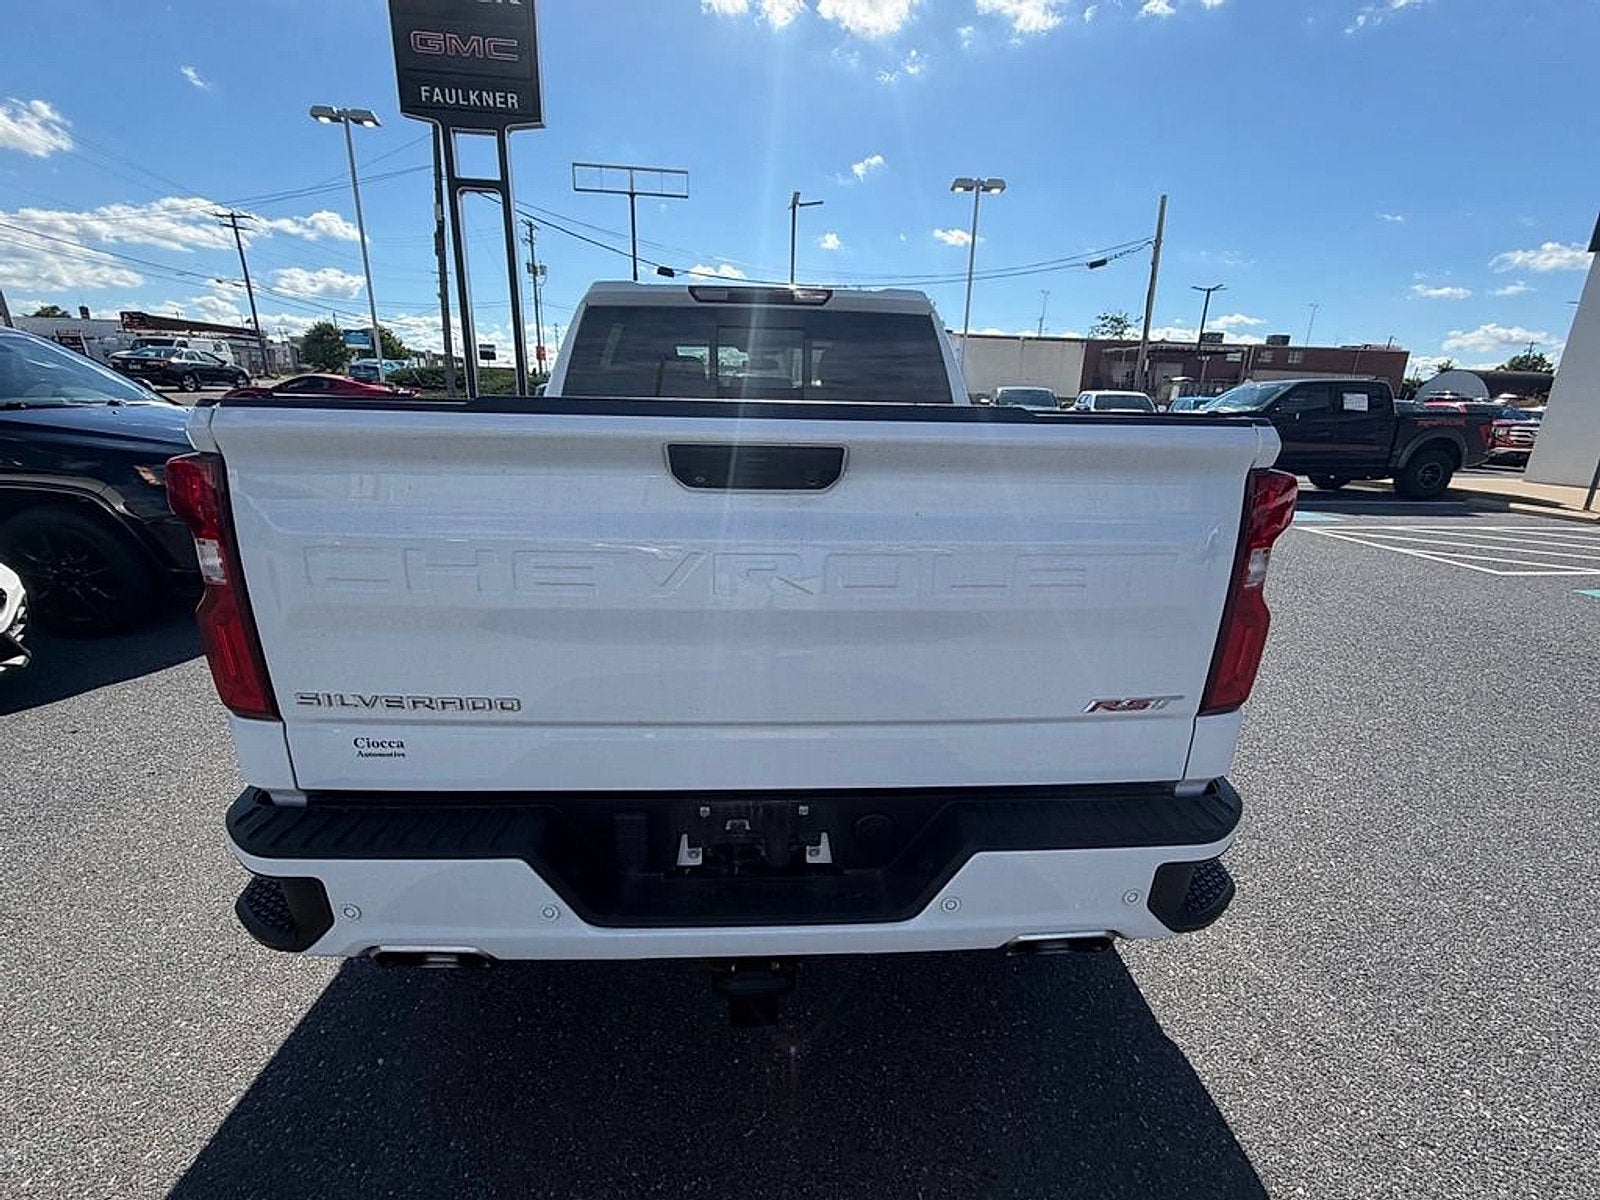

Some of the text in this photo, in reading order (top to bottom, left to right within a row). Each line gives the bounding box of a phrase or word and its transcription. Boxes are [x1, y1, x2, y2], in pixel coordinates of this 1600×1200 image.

[410, 30, 519, 61] GMC
[420, 86, 519, 109] FAULKNER
[303, 545, 1178, 600] CHEVROLET
[296, 692, 521, 712] SILVERADO
[1083, 695, 1184, 713] RST
[353, 737, 405, 749] Ciocca
